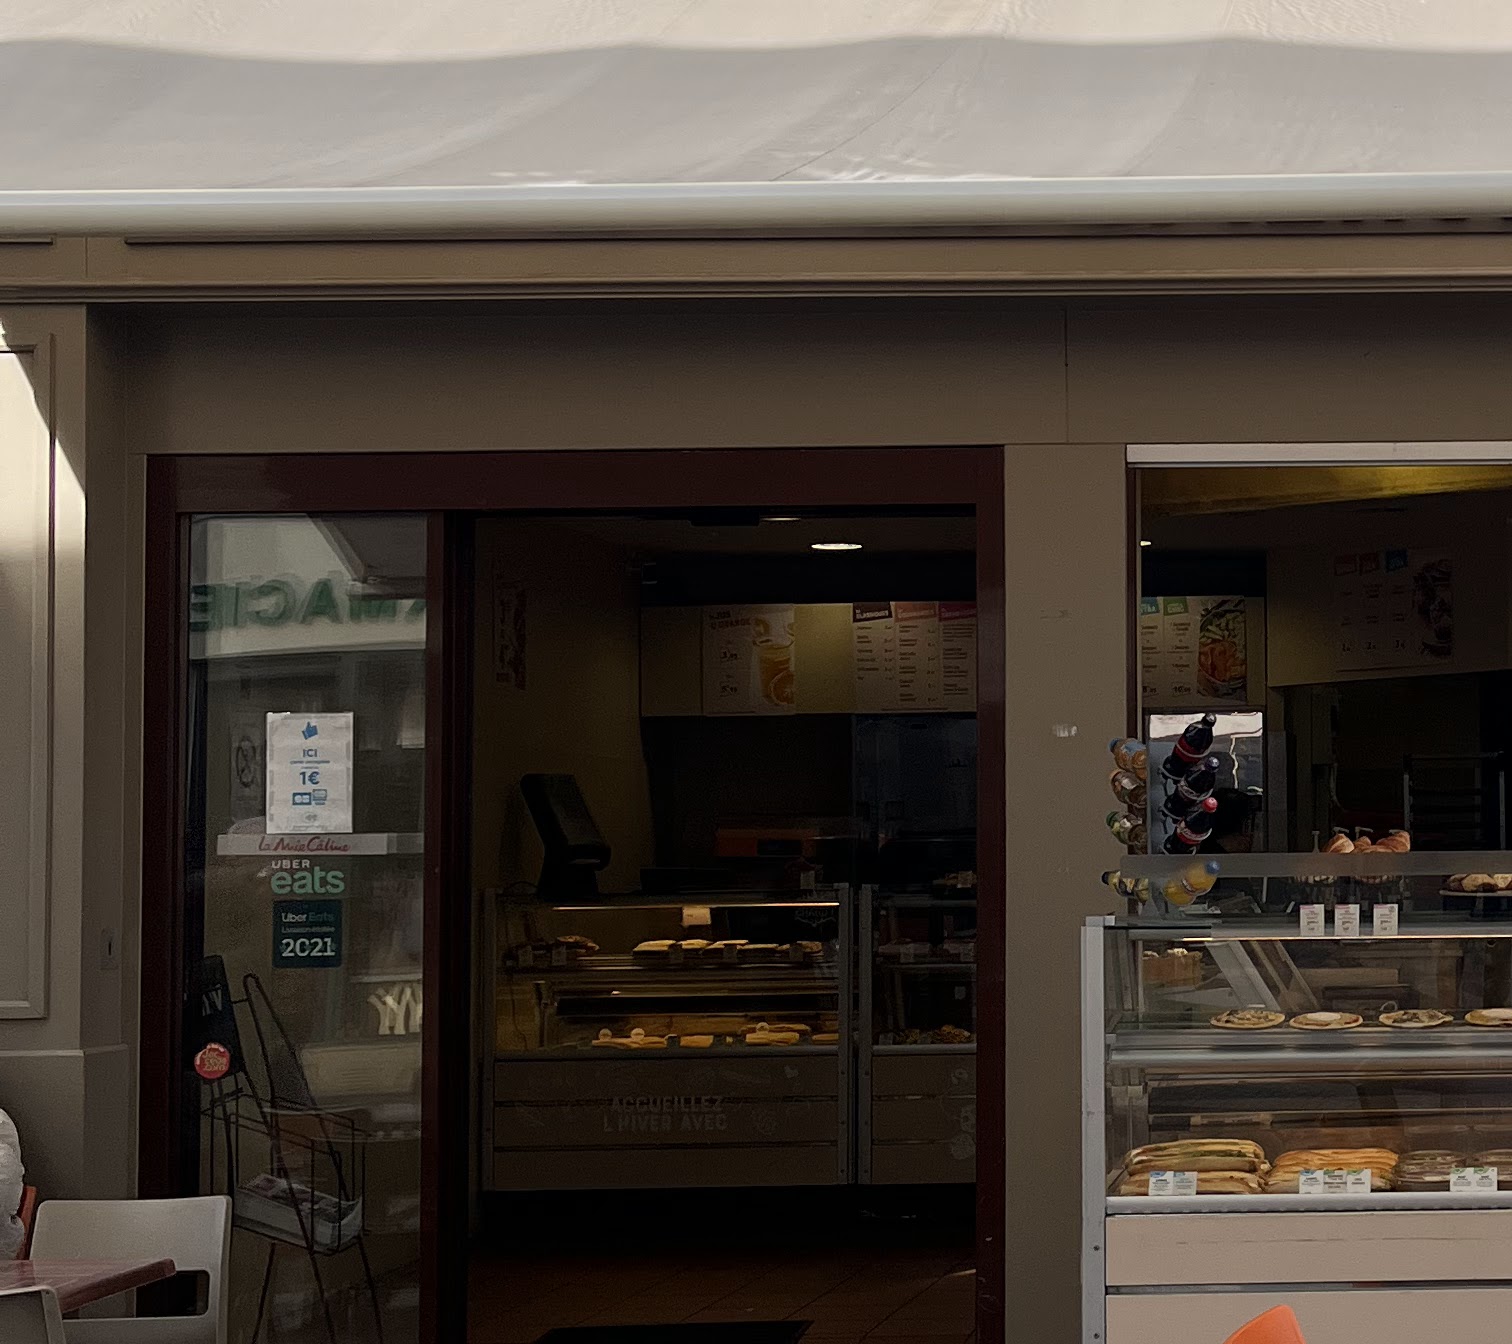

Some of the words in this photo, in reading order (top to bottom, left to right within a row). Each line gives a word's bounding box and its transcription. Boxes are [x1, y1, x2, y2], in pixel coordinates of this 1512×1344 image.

[302, 748, 318, 758] ICI
[299, 771, 320, 786] 1€
[271, 859, 311, 869] UBER
[270, 865, 346, 895] eats
[281, 937, 336, 957] 2021
